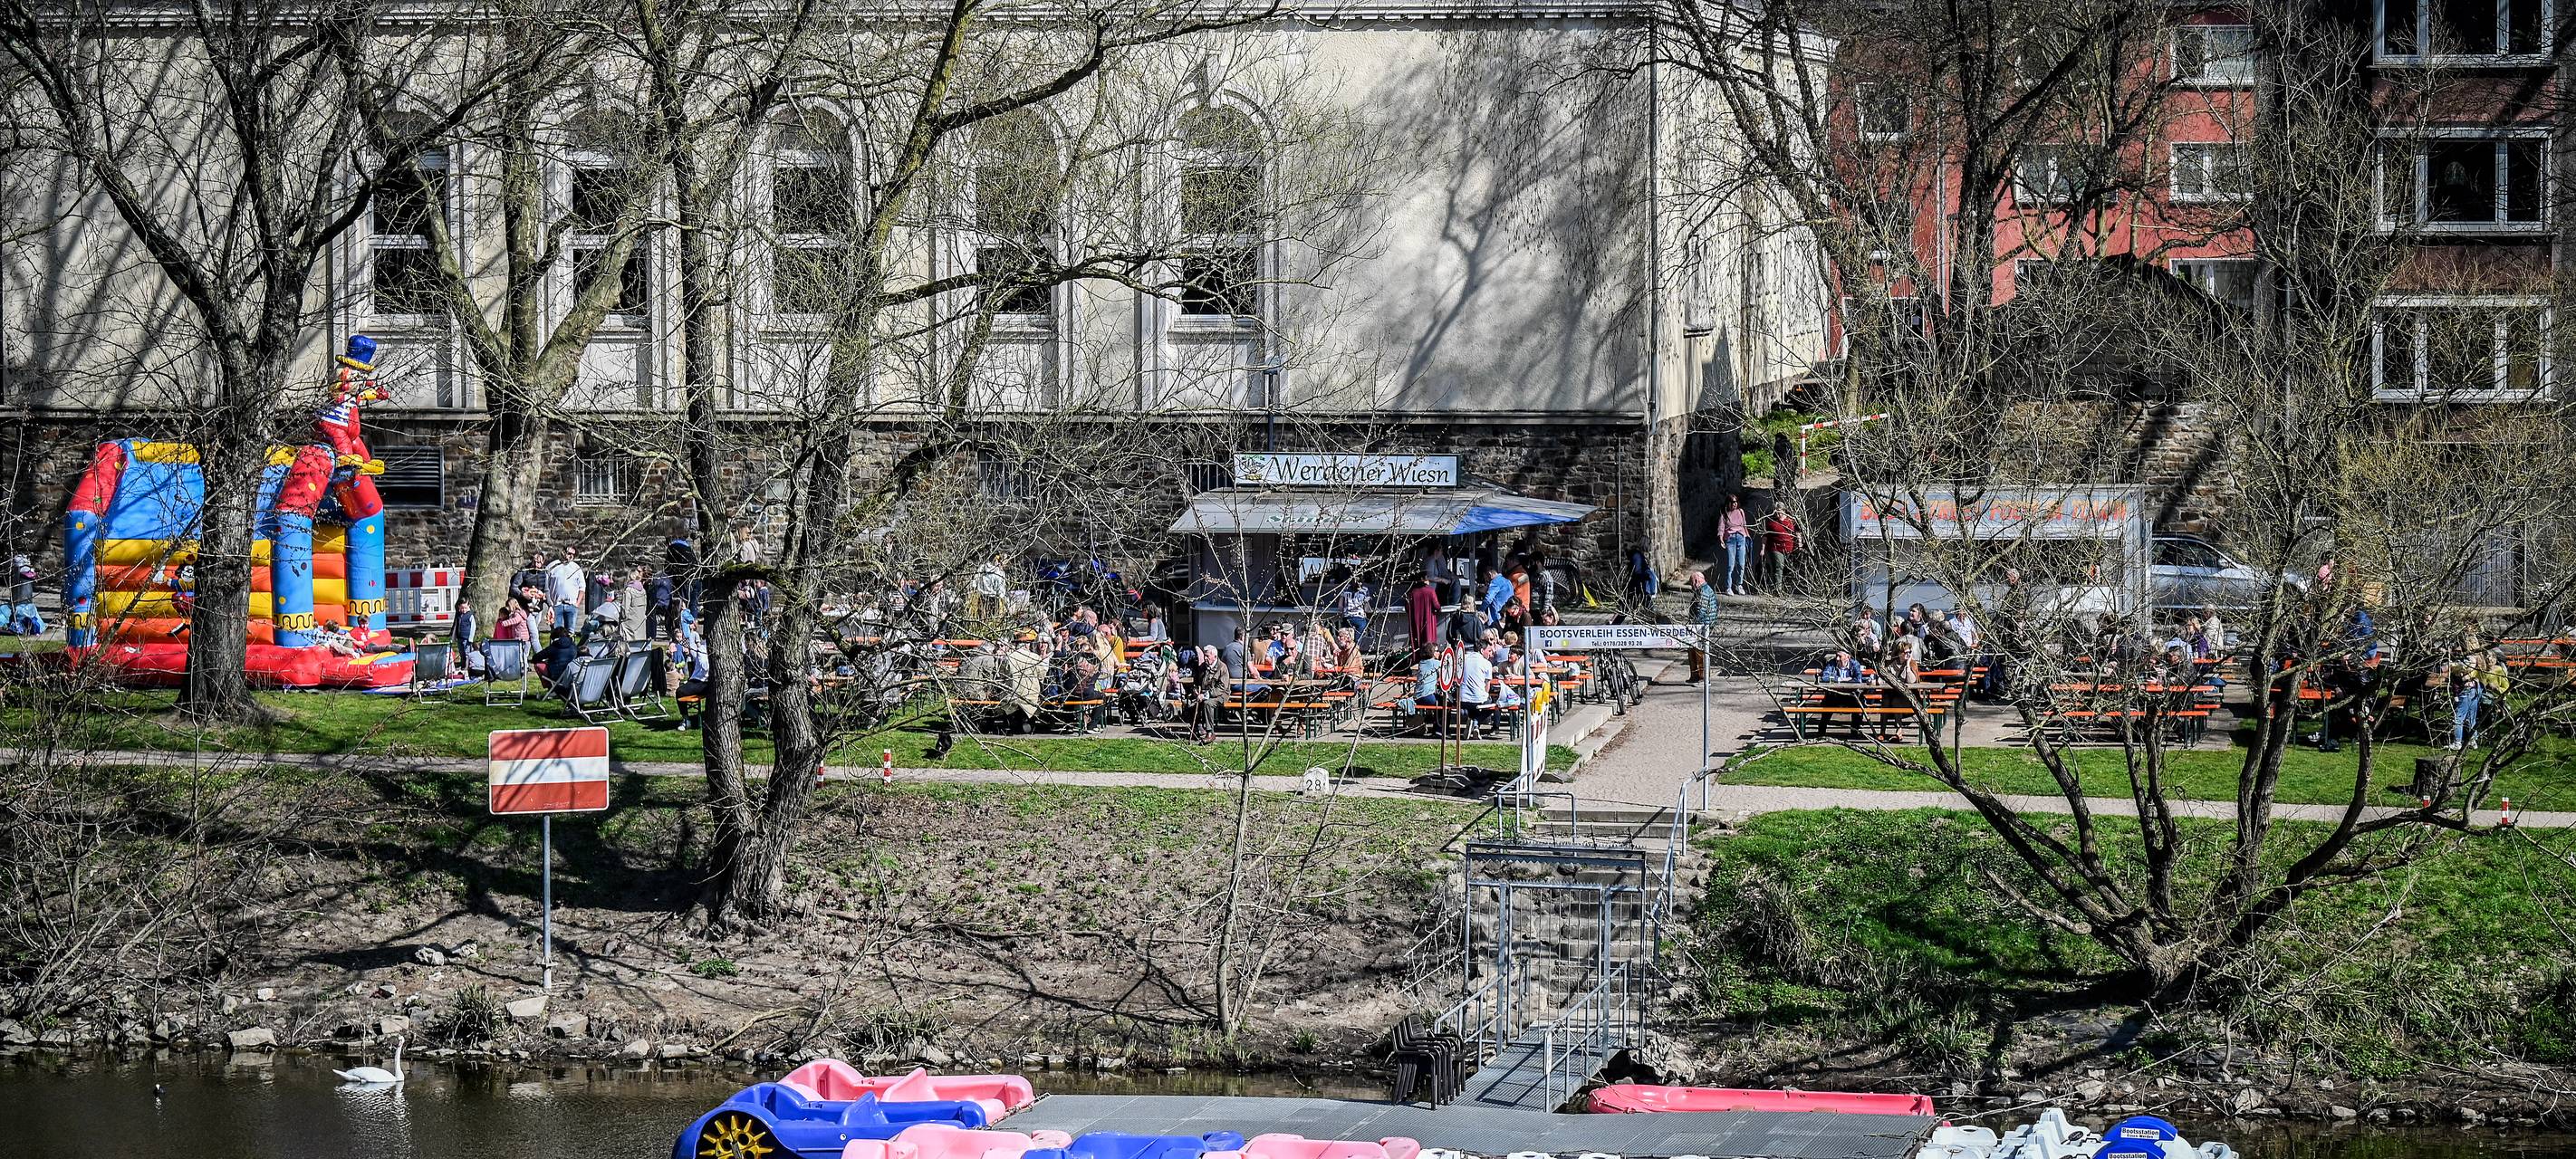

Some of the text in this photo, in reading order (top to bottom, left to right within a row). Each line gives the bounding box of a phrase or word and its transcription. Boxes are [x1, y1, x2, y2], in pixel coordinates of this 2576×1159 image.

[1273, 455, 1385, 482] Werdener
[1387, 462, 1450, 483] Wiesn
[1539, 627, 1693, 638] BOOTSVERLEIH ESSEN-WERDEN
[1305, 779, 1322, 791] 28
[2122, 1127, 2159, 1135] Bootsstation
